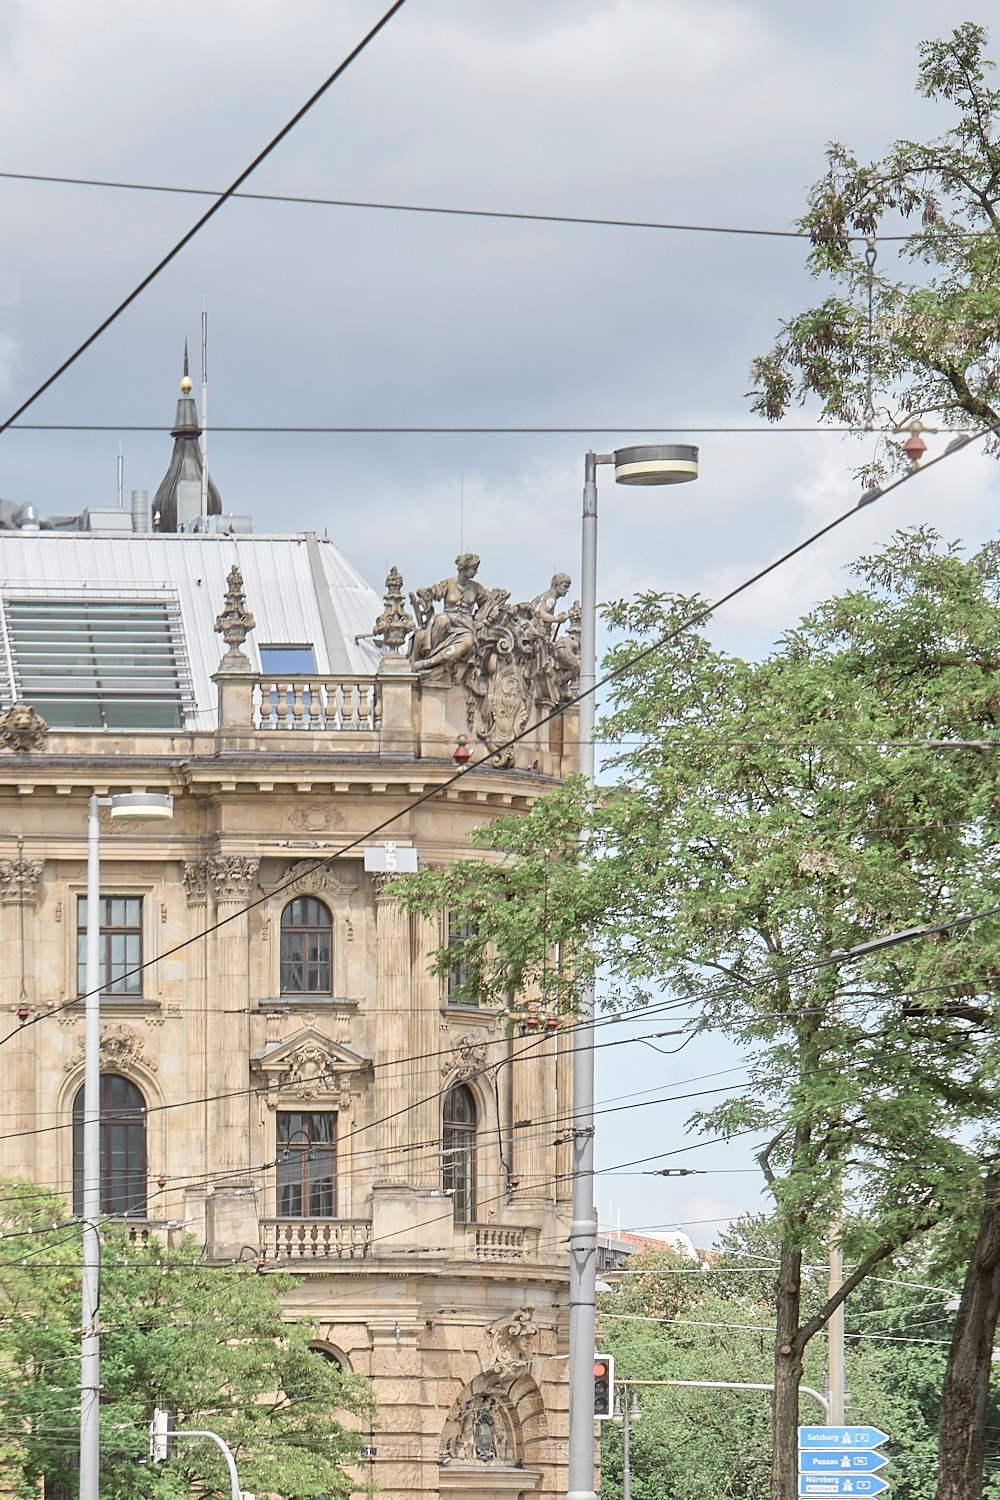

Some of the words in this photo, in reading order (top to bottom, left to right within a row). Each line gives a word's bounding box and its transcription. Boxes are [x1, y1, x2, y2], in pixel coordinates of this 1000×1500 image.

[385, 852, 397, 870] 5
[807, 1433, 839, 1442] Salzburg
[812, 1457, 838, 1465] Passau
[805, 1475, 839, 1484] Nürnberg
